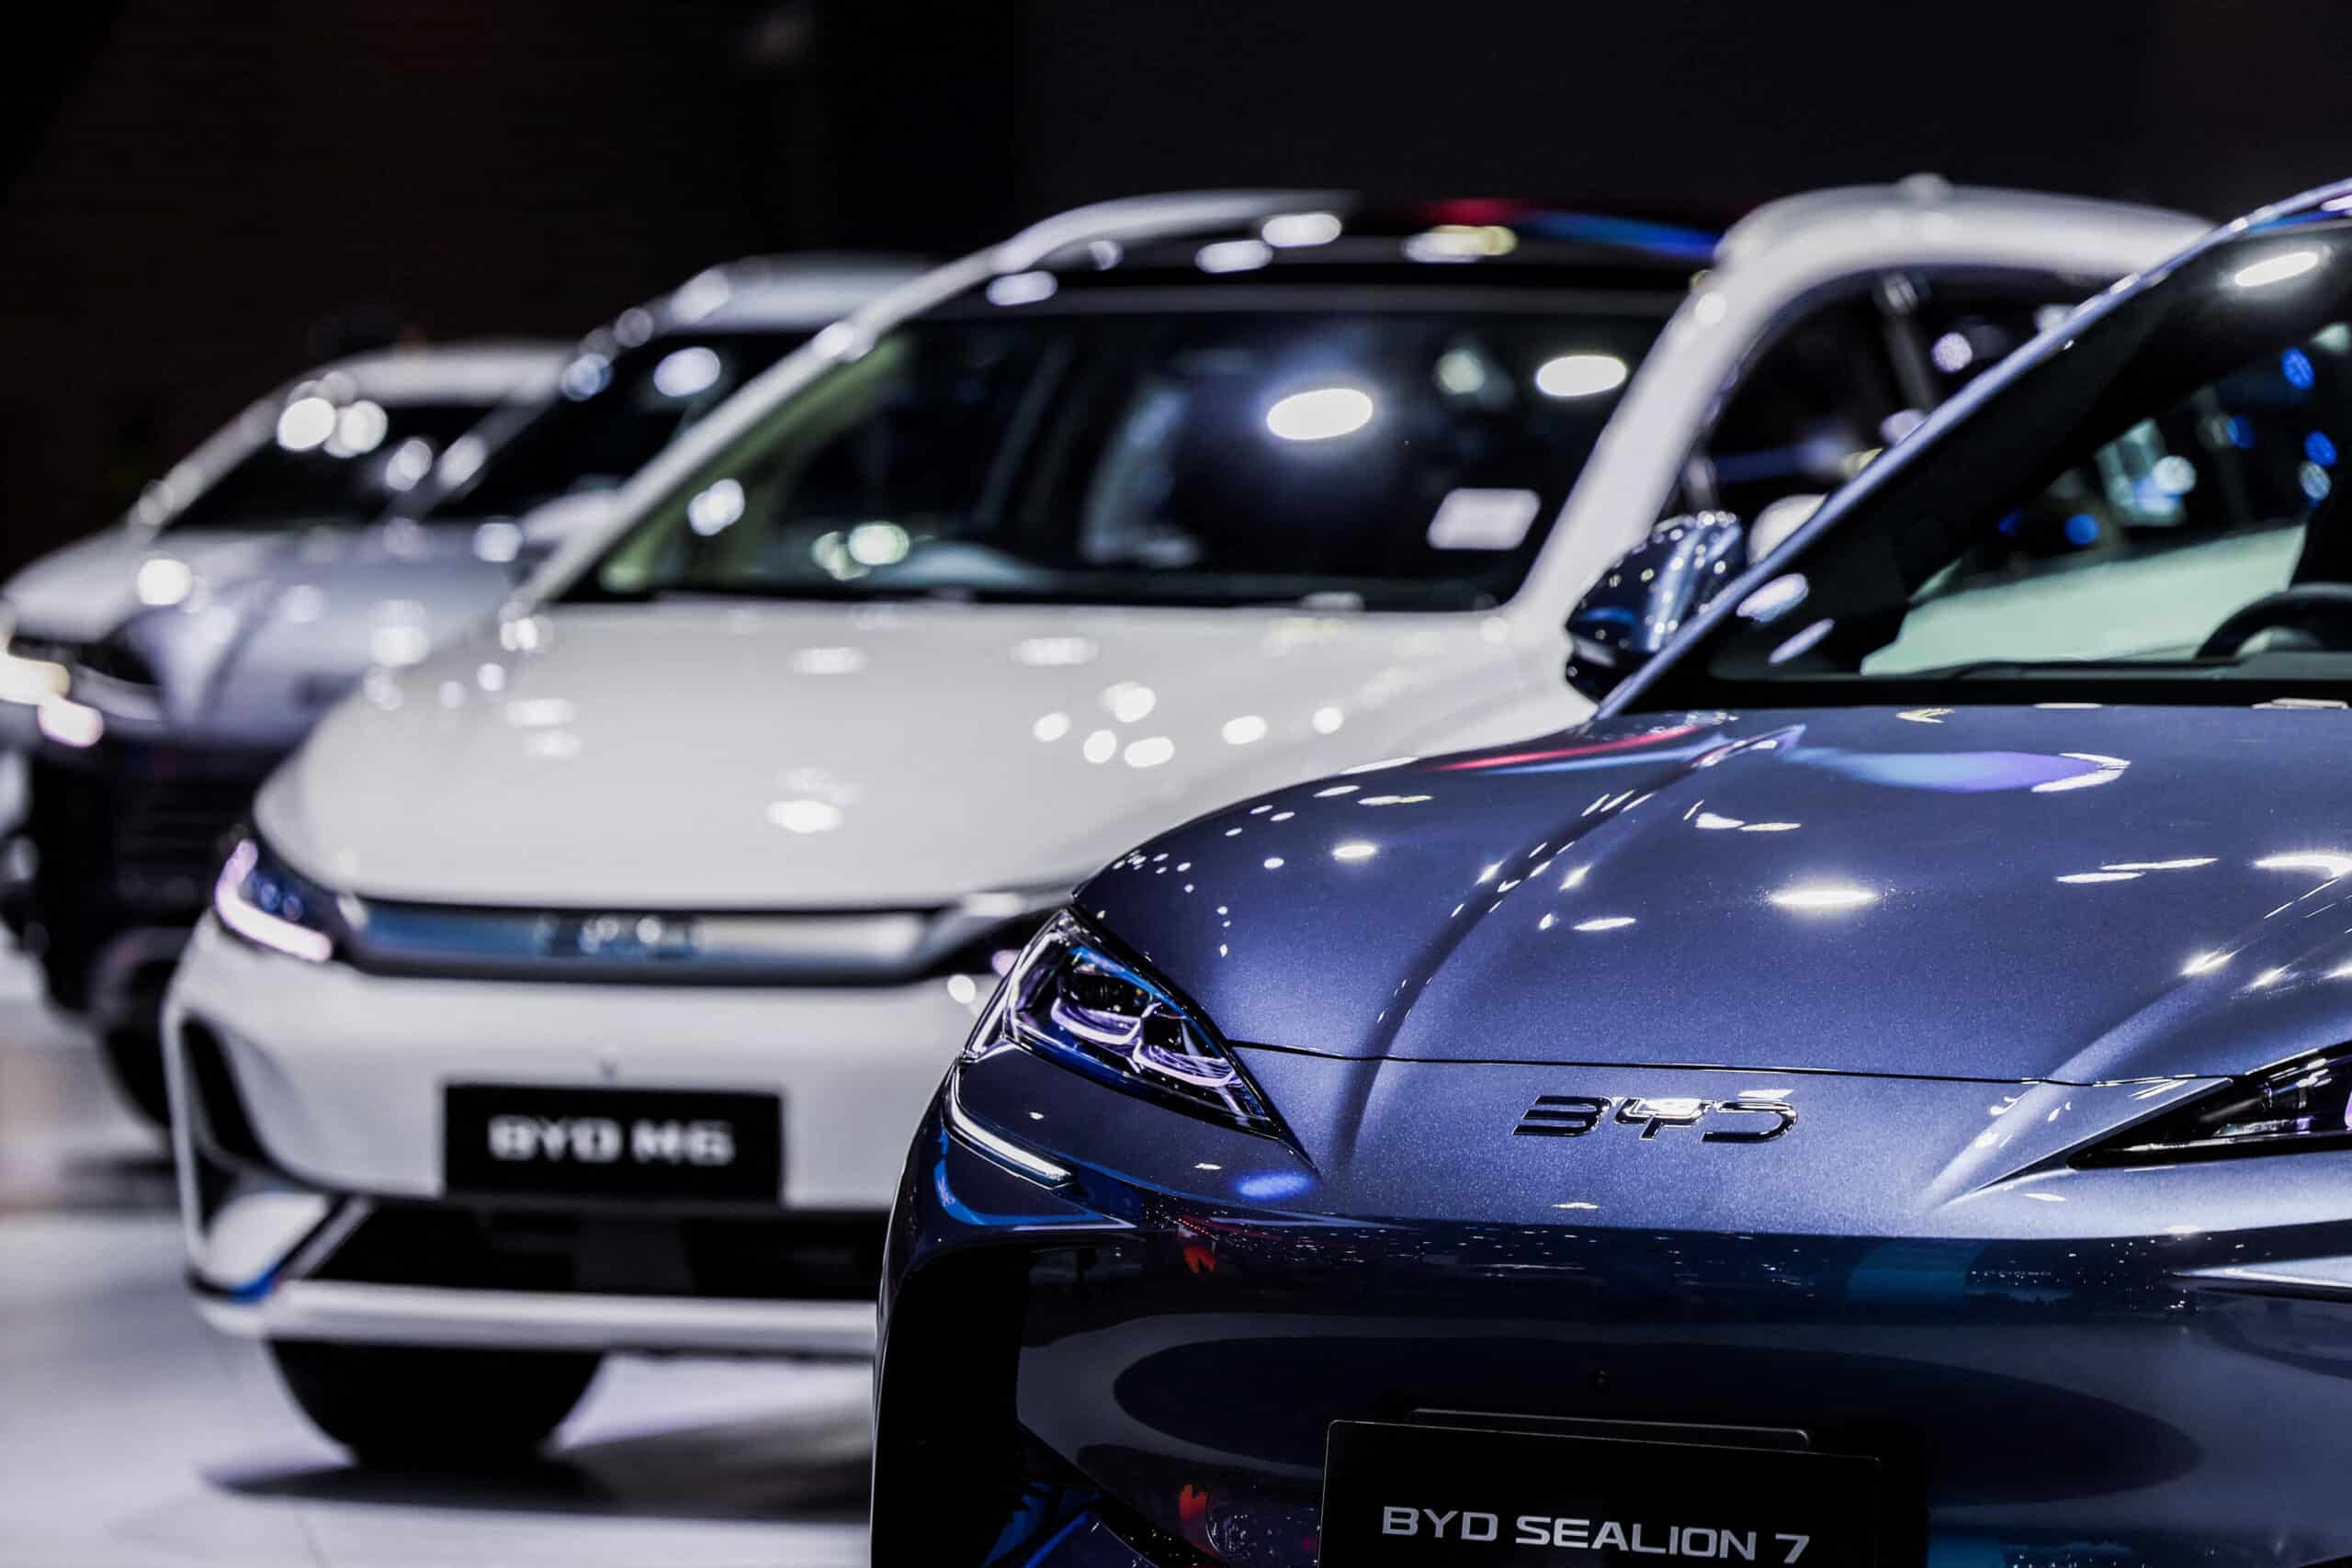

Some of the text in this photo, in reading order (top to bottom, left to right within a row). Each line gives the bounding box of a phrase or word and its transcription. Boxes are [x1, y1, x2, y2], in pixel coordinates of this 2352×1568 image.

[489, 1116, 734, 1164] BYD M6
[1382, 1506, 1810, 1564] BYD SEALION 7
